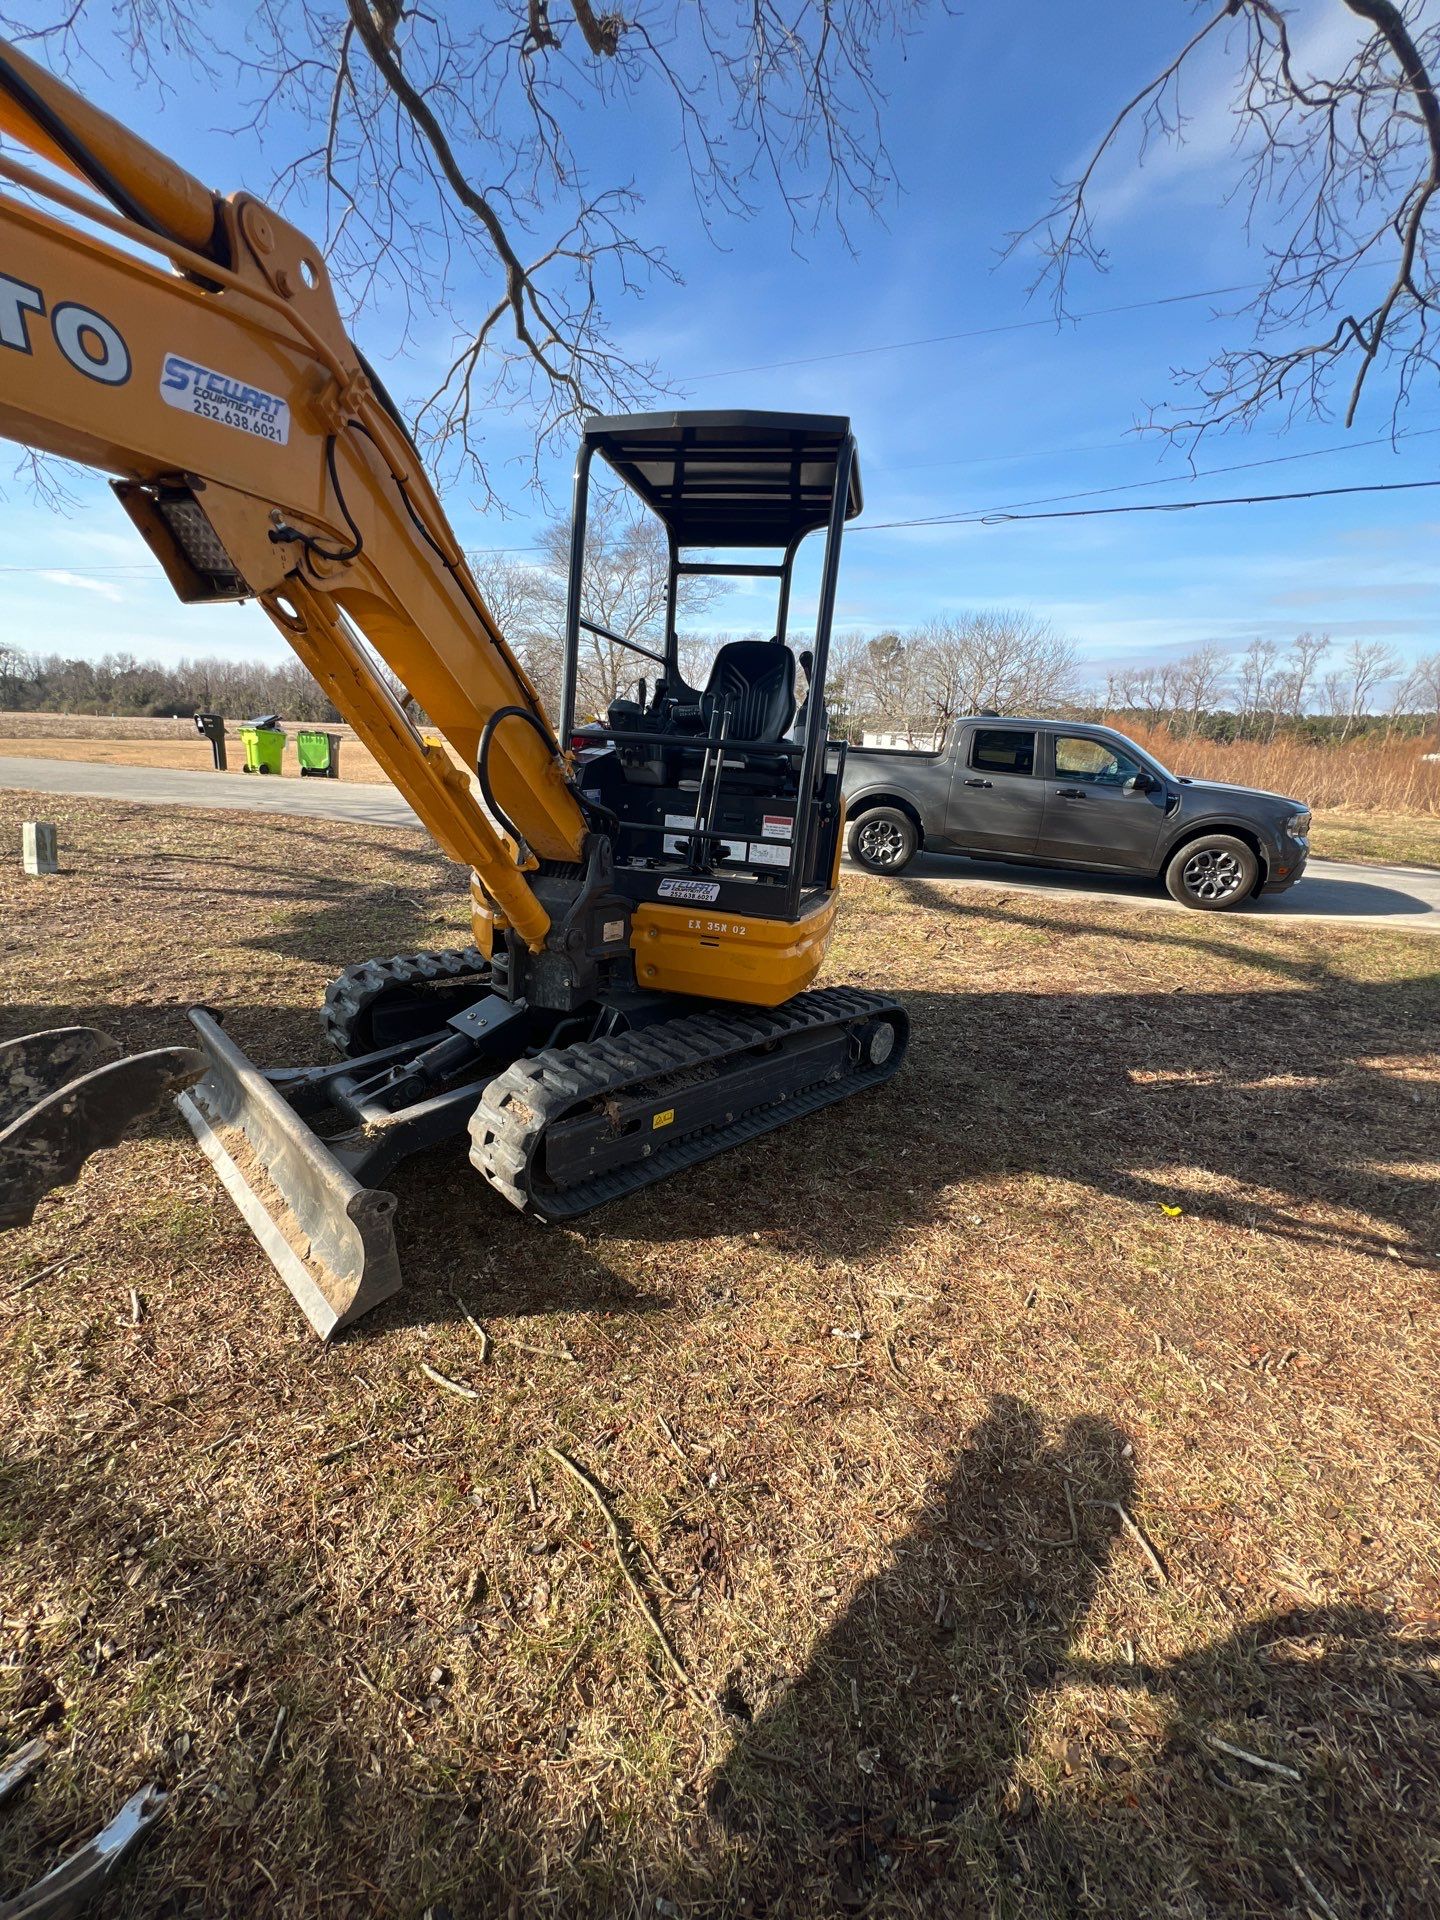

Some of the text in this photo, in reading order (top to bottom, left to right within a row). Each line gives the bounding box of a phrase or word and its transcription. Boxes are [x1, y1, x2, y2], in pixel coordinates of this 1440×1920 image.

[162, 357, 285, 415] STEWART
[193, 386, 259, 418] EQUIPMENT
[193, 399, 282, 442] 252.638.6021
[660, 880, 718, 891] STEWART
[688, 919, 701, 929] EX
[732, 925, 746, 935] 02
